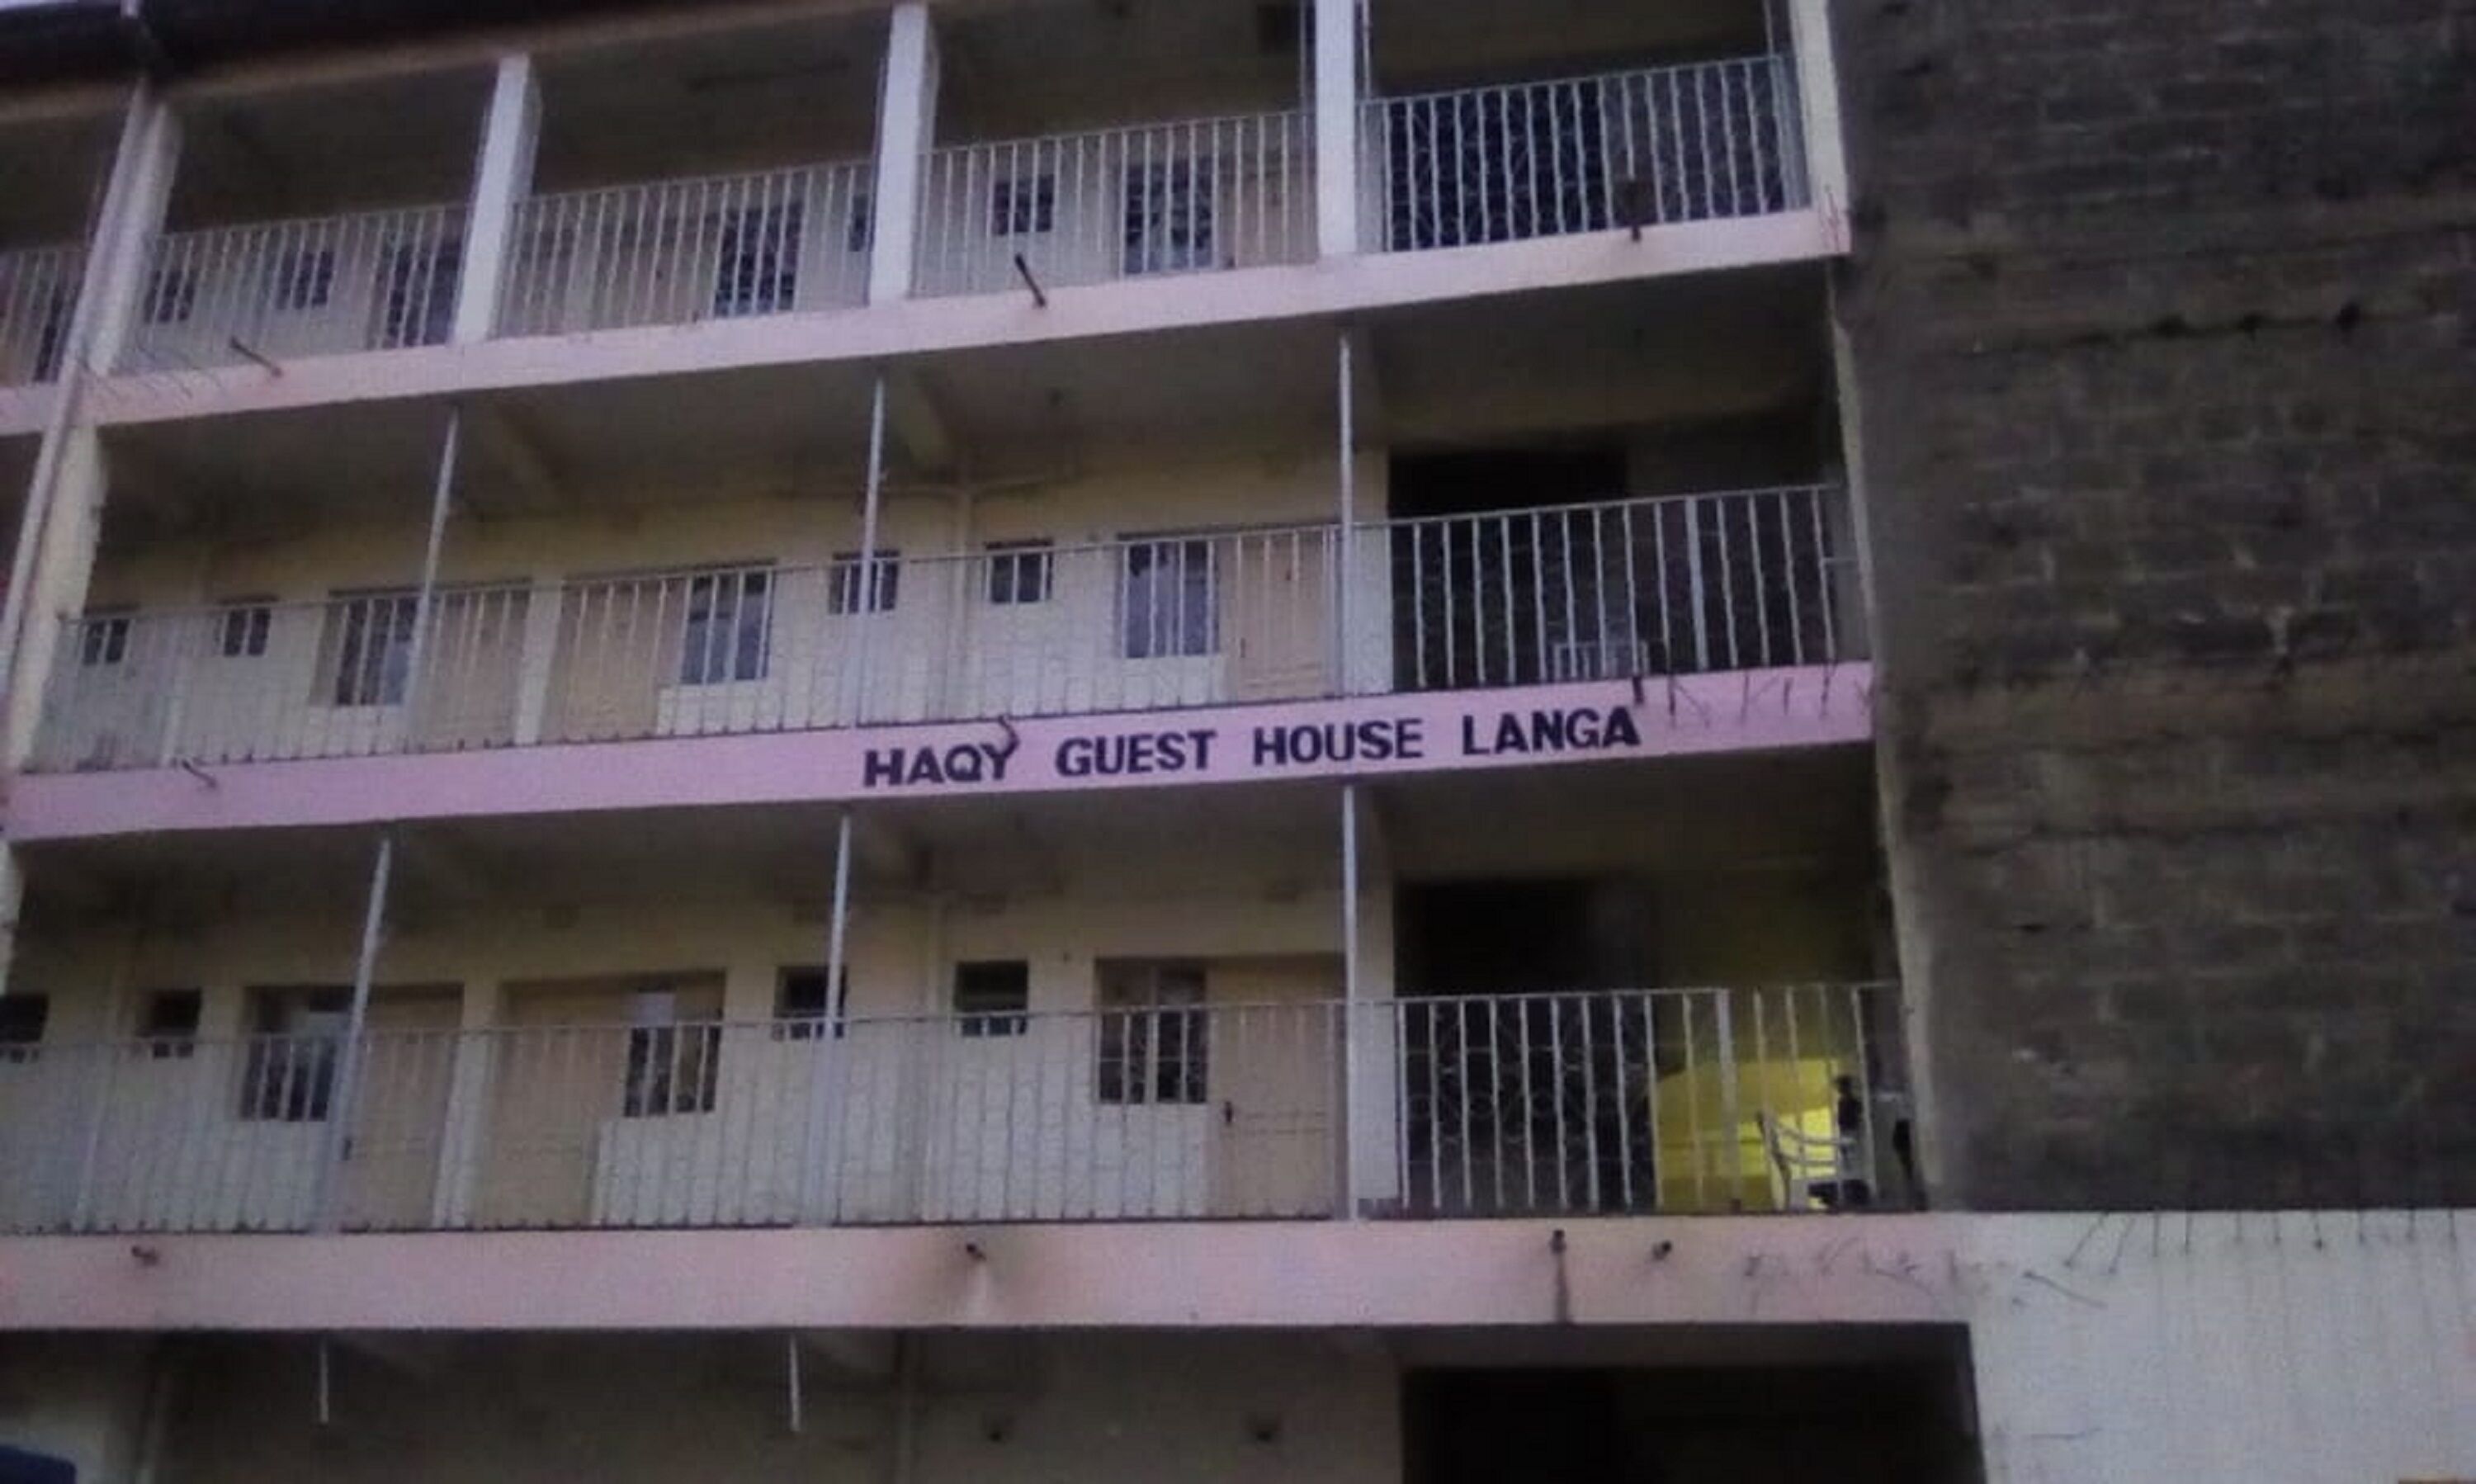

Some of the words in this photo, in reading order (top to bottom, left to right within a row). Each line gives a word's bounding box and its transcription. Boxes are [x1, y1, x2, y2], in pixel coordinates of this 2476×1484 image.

[863, 741, 1019, 787] HAQY
[1055, 730, 1217, 777] GUEST
[1253, 718, 1423, 765] HOUSE
[1462, 707, 1641, 755] LANGA
